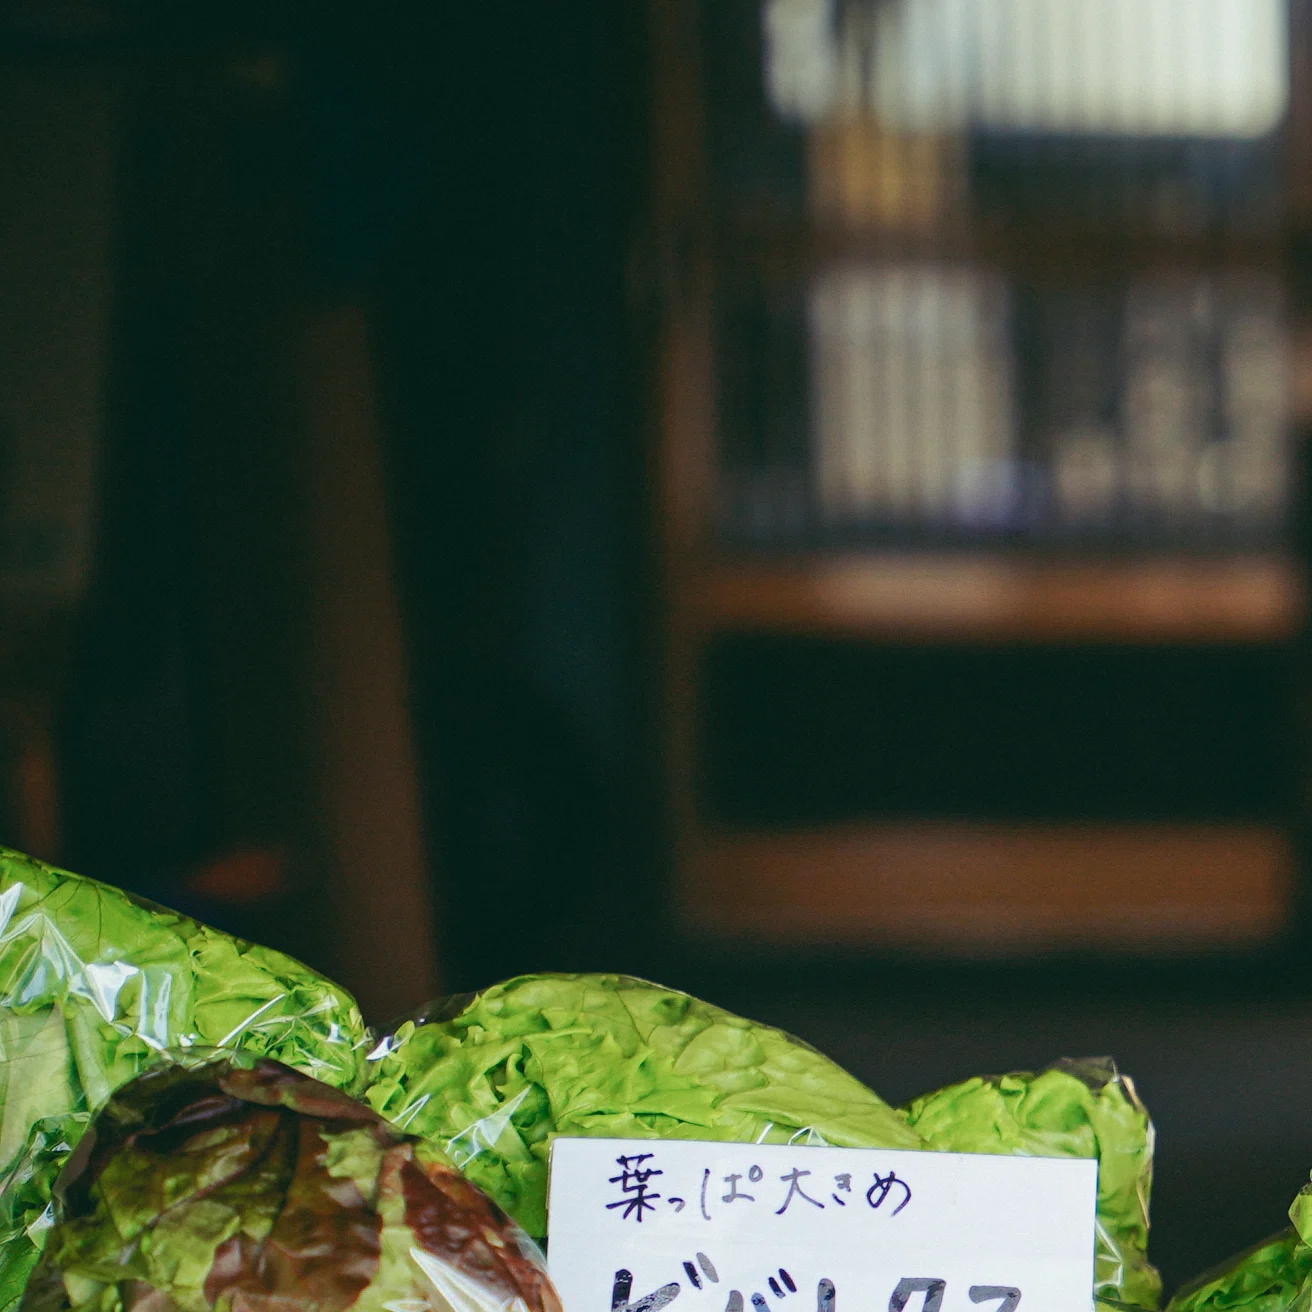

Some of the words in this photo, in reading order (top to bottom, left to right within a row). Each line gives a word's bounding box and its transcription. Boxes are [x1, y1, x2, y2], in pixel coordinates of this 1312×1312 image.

[607, 1153, 912, 1222] 葉っぱ大きめ
